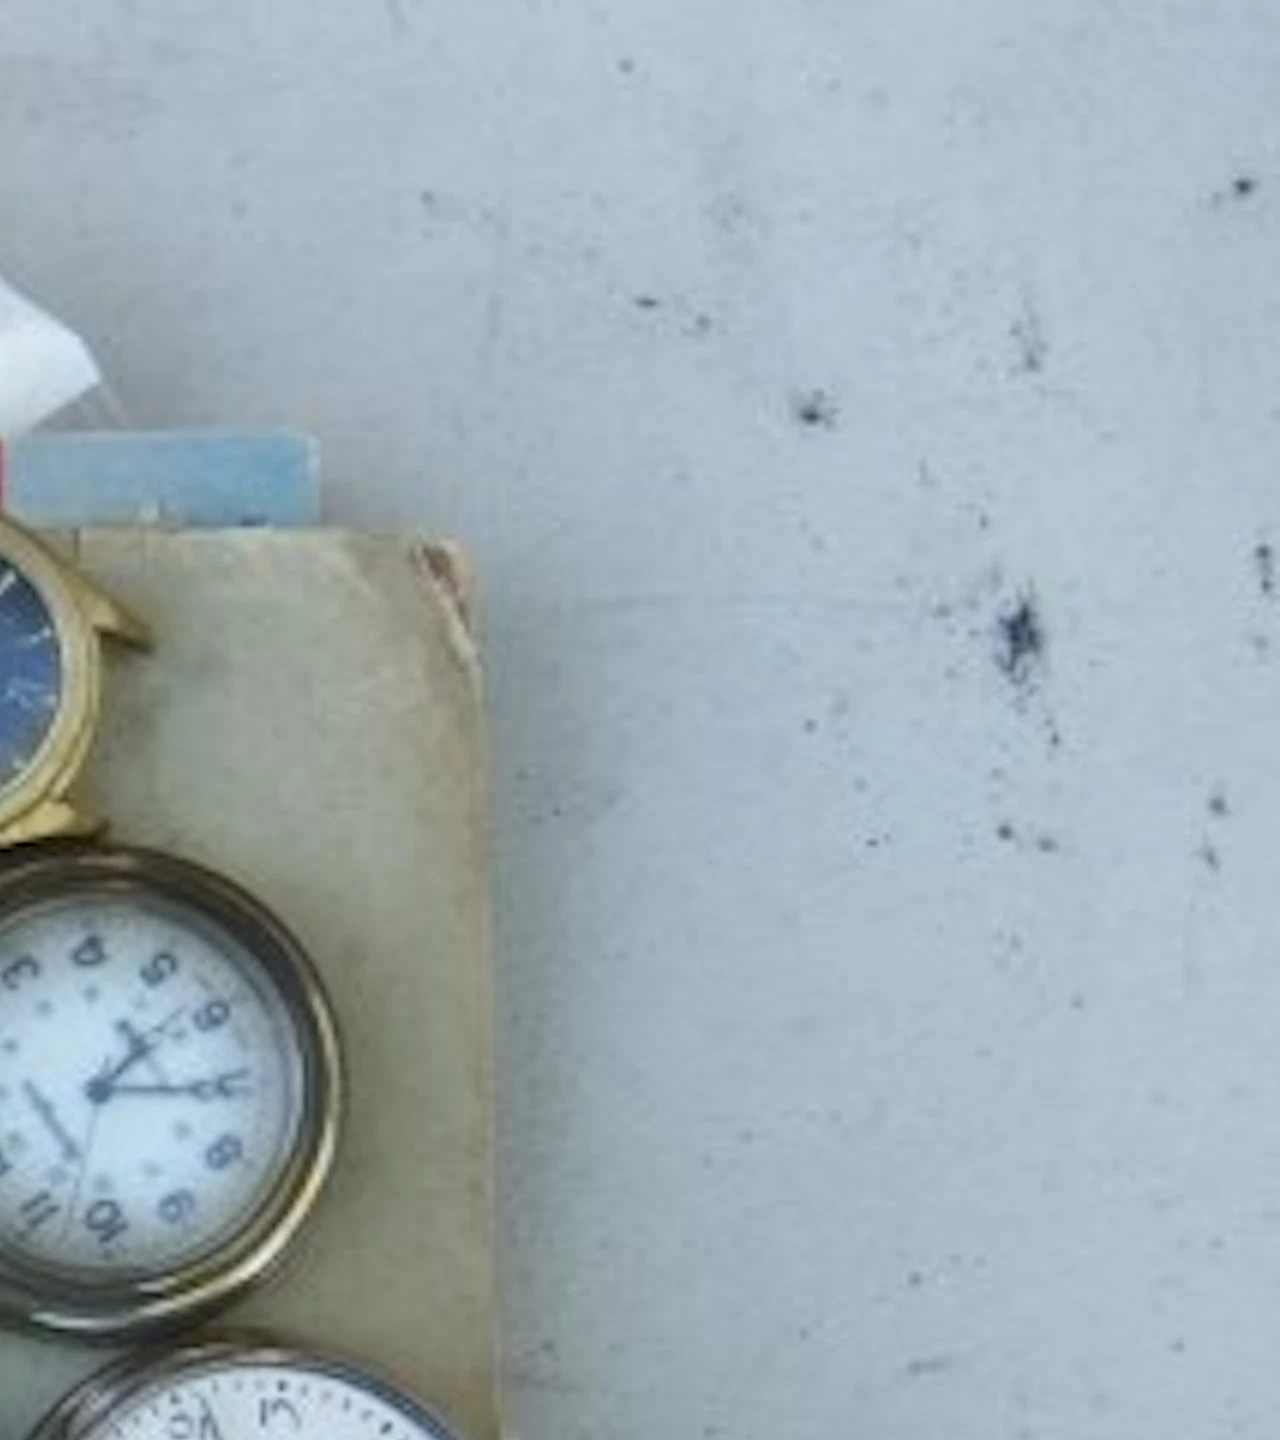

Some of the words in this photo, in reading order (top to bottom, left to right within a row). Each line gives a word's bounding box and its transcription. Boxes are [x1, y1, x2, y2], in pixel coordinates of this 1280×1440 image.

[71, 934, 107, 967] 4
[0, 956, 39, 991] 3
[141, 952, 178, 987] 5
[193, 1001, 231, 1032] 6
[204, 1134, 242, 1170] 8
[20, 1191, 60, 1227] 11
[84, 1199, 129, 1243] 10
[157, 1189, 195, 1224] 9
[258, 1397, 301, 1429] 3
